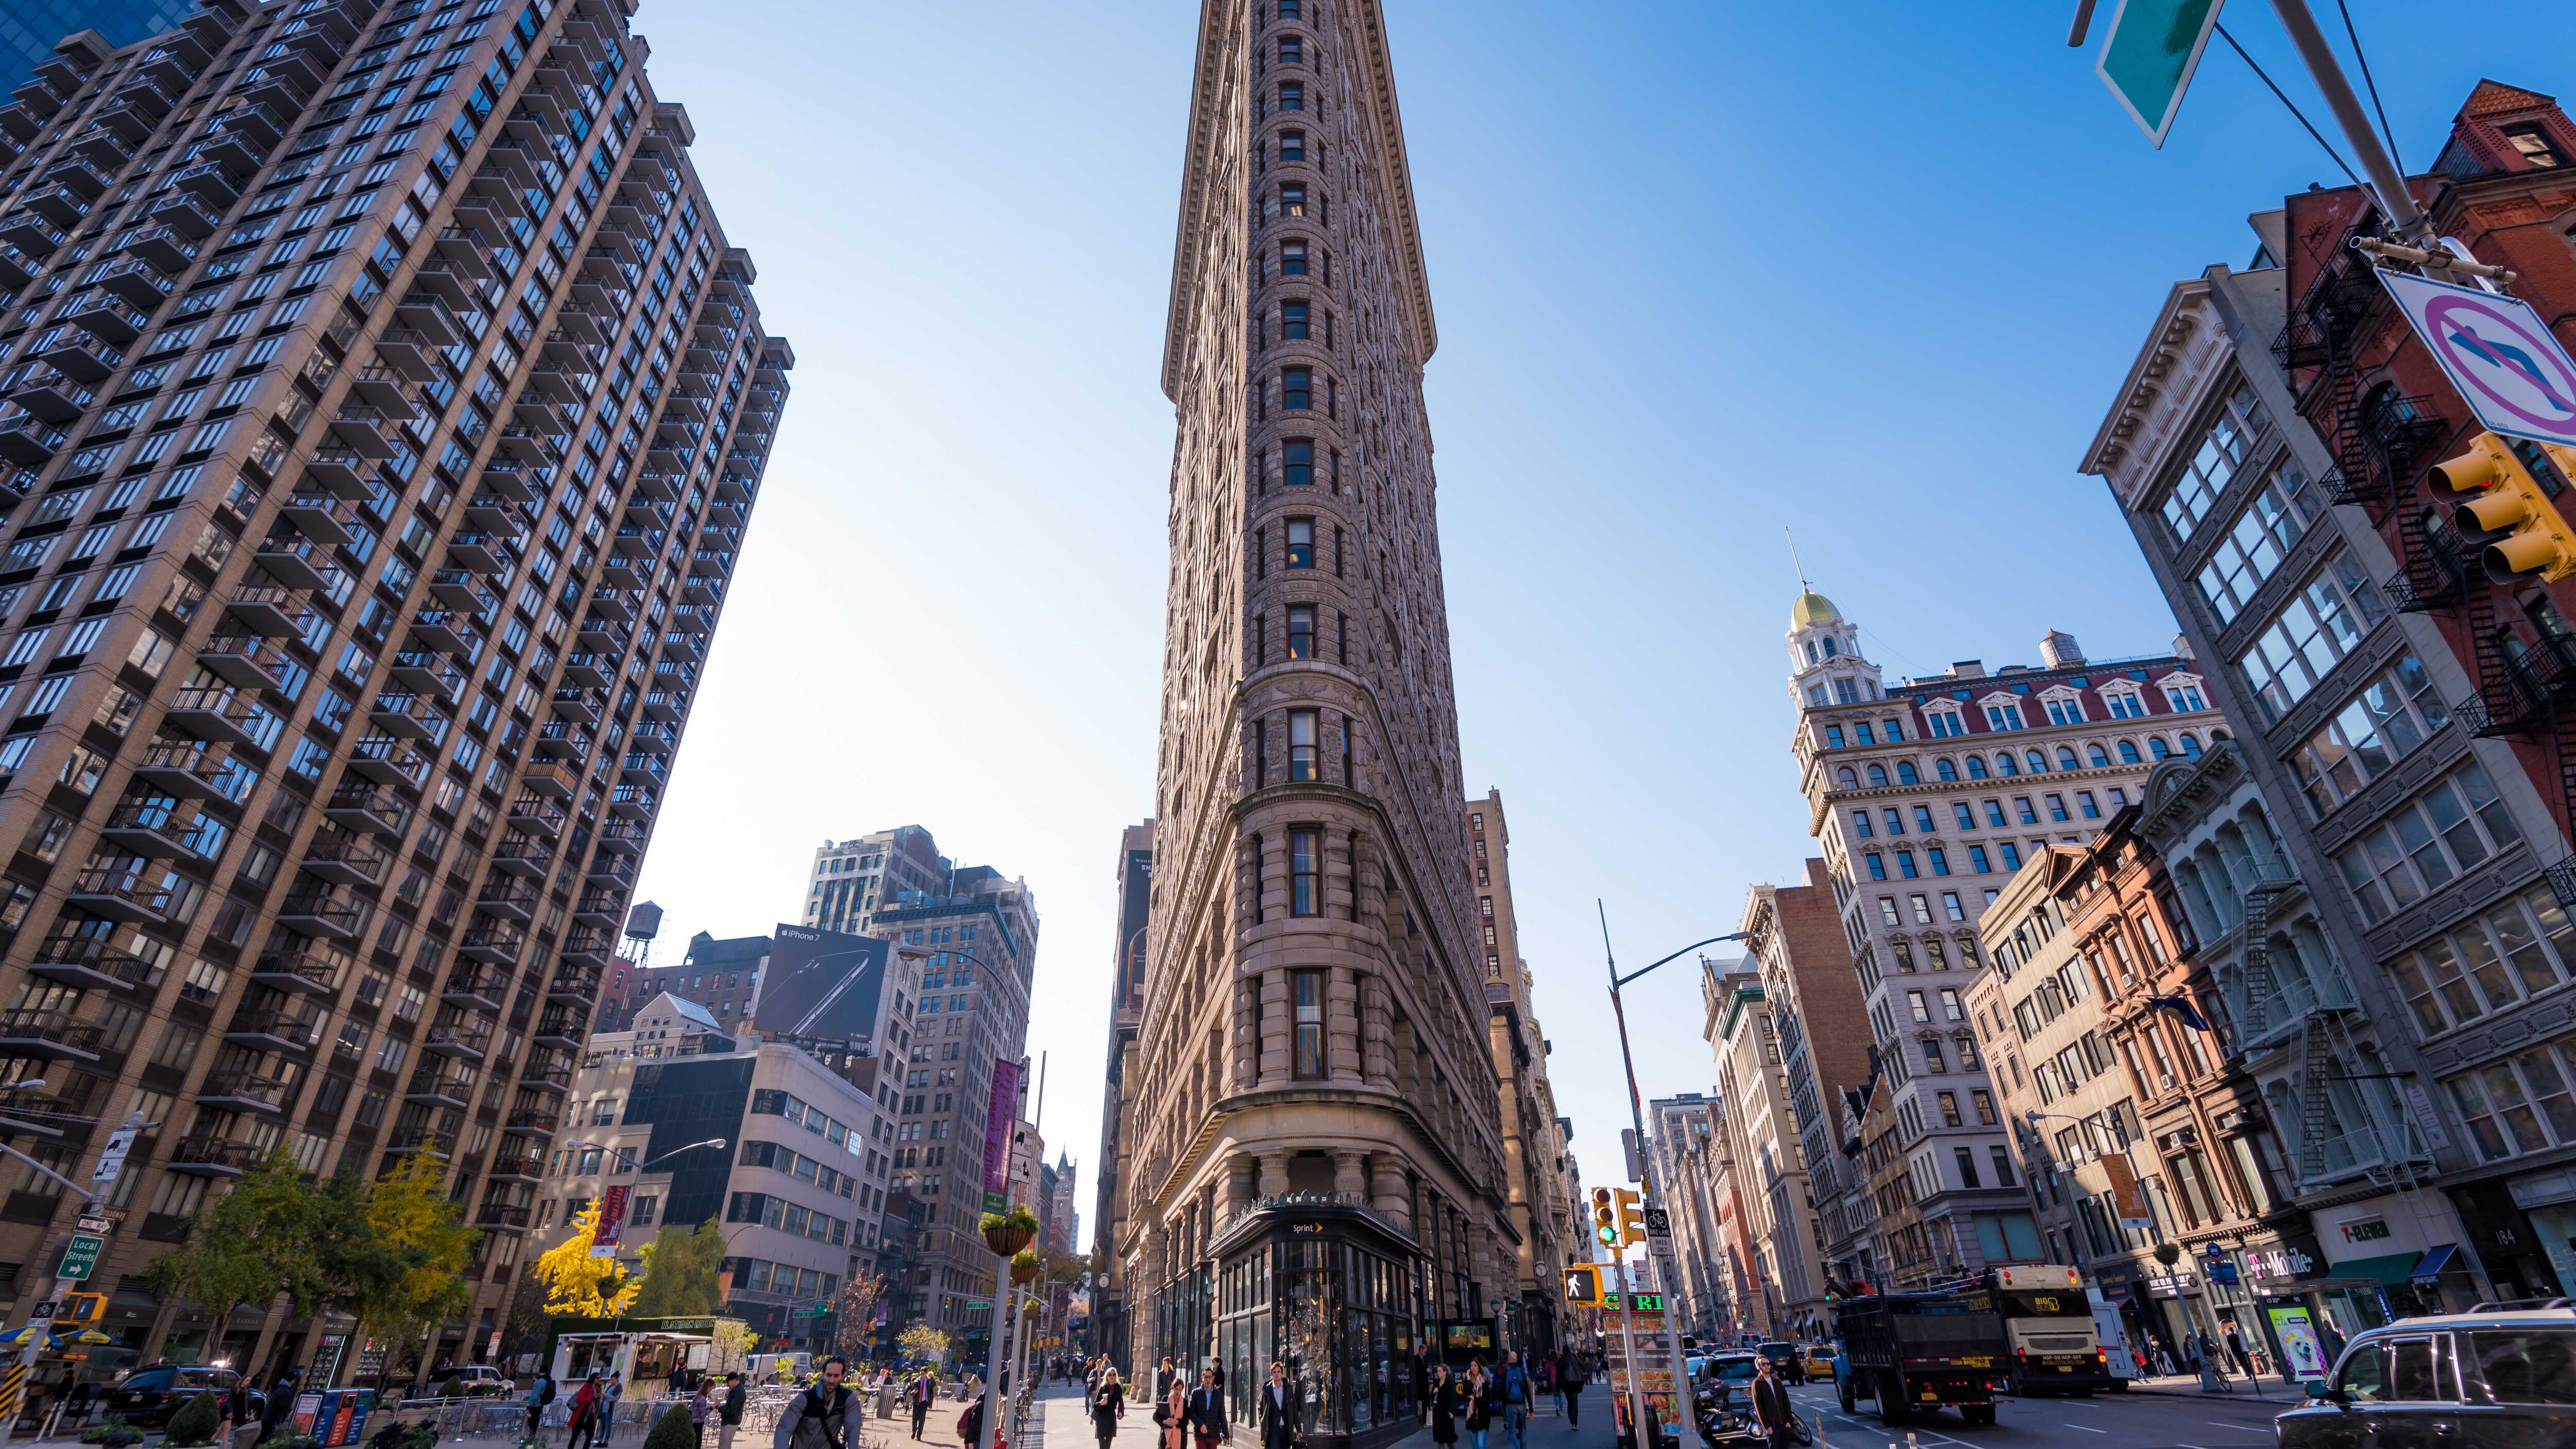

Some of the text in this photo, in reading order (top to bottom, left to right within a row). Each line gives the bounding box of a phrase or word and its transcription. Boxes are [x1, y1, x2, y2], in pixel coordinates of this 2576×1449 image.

[788, 929, 814, 941] iPhone
[1025, 1131, 1033, 1139] TRUCK
[1024, 1142, 1032, 1151] ROUTE
[106, 1165, 119, 1173] LOCAL
[1011, 1163, 1022, 1172] LOCAL
[99, 1208, 126, 1221] Broadway
[96, 1221, 107, 1230] WAY
[1293, 1224, 1313, 1234] Sprint
[2495, 1229, 2516, 1245] 184
[74, 1240, 98, 1250] Local
[67, 1251, 95, 1262] Streets
[2378, 1293, 2387, 1311] Avenue
[660, 1319, 716, 1329] FLATIRON GREEN
